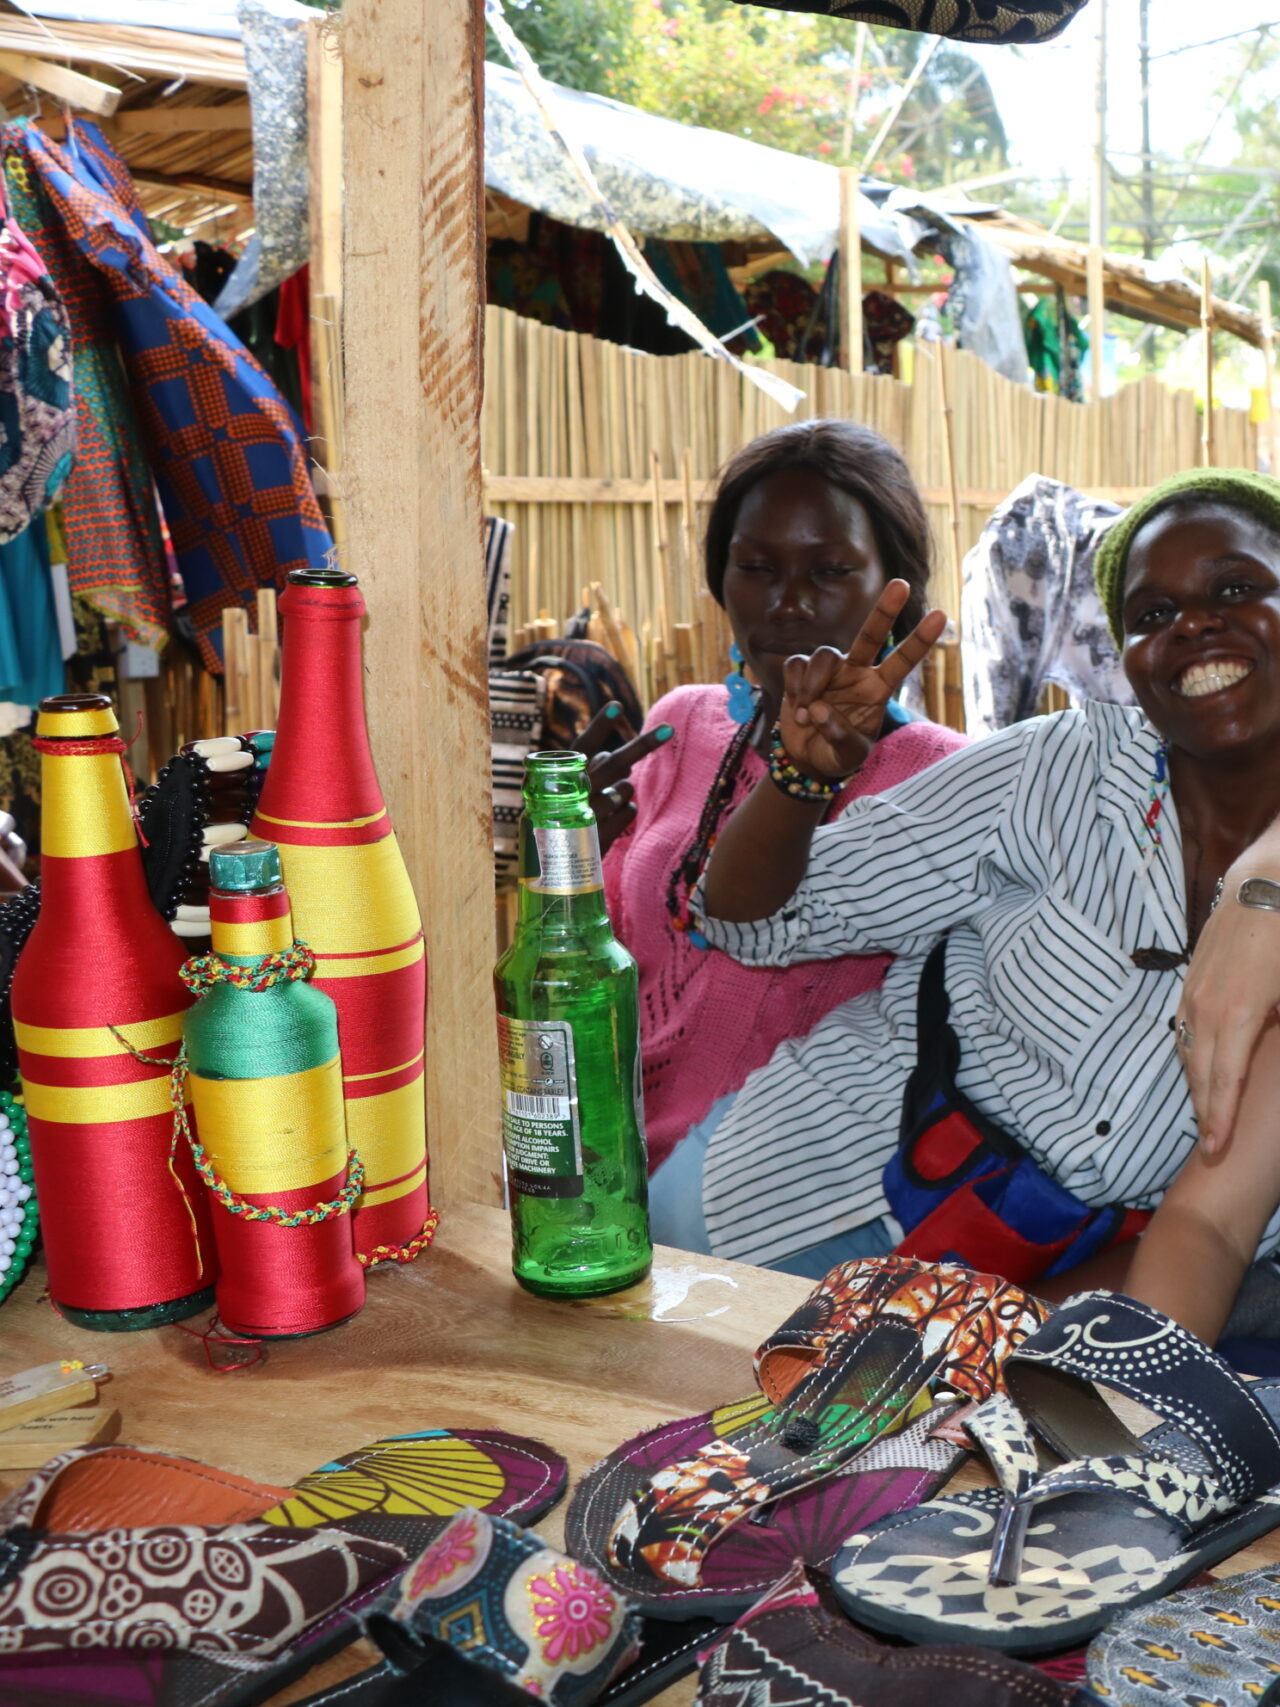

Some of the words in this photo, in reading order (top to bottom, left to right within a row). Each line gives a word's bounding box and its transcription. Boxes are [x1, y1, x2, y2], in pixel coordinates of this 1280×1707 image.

[522, 1120, 530, 1128] TO
[531, 1121, 564, 1130] PERSONS
[513, 1124, 523, 1132] AGE
[524, 1127, 532, 1136] OF
[543, 1129, 569, 1137] YEARS.
[521, 1136, 552, 1145] ALCOHOL
[531, 1145, 560, 1153] IMPAIRS
[520, 1156, 539, 1166] DRIVE
[519, 1163, 556, 1174] MACHINERY
